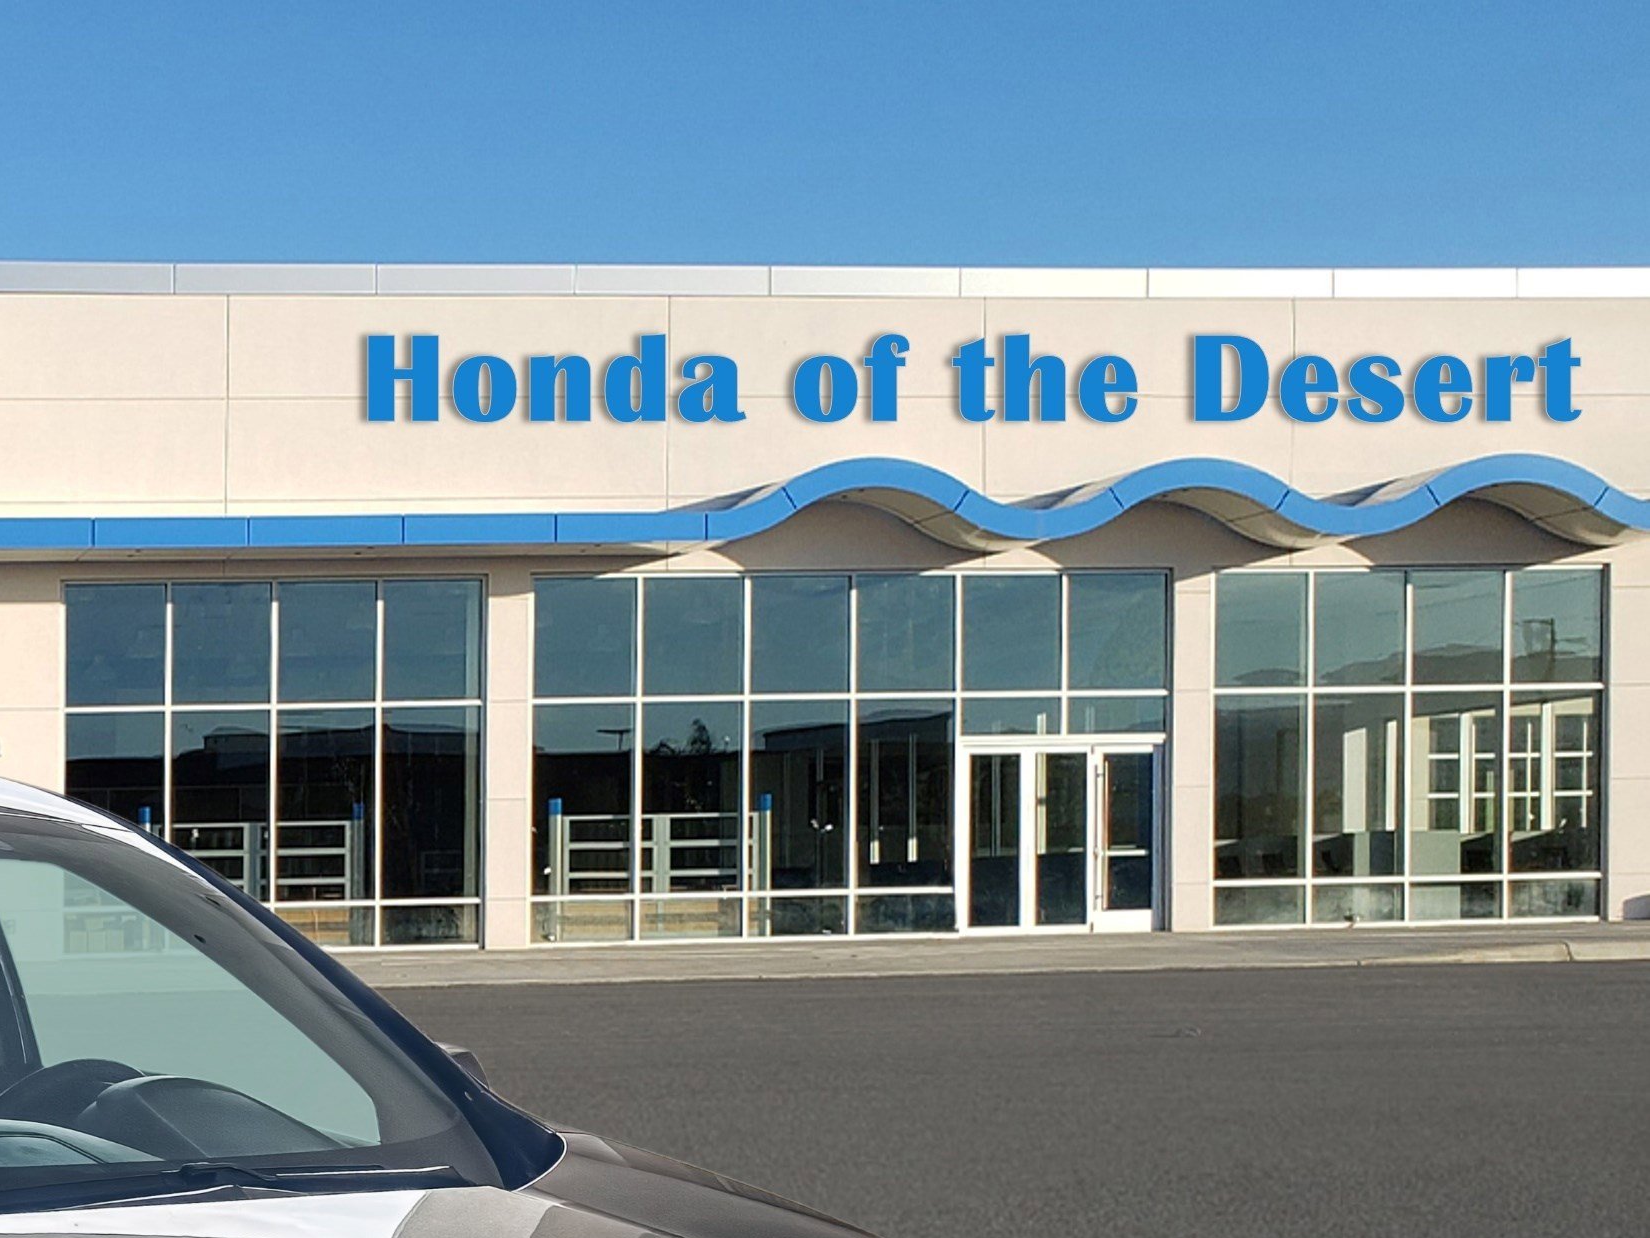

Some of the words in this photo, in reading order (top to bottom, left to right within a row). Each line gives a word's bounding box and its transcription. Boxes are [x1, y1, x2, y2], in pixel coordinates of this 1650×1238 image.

[367, 333, 746, 424] Honda
[793, 333, 910, 424] of
[952, 333, 1138, 424] the
[1194, 333, 1582, 424] Desert
